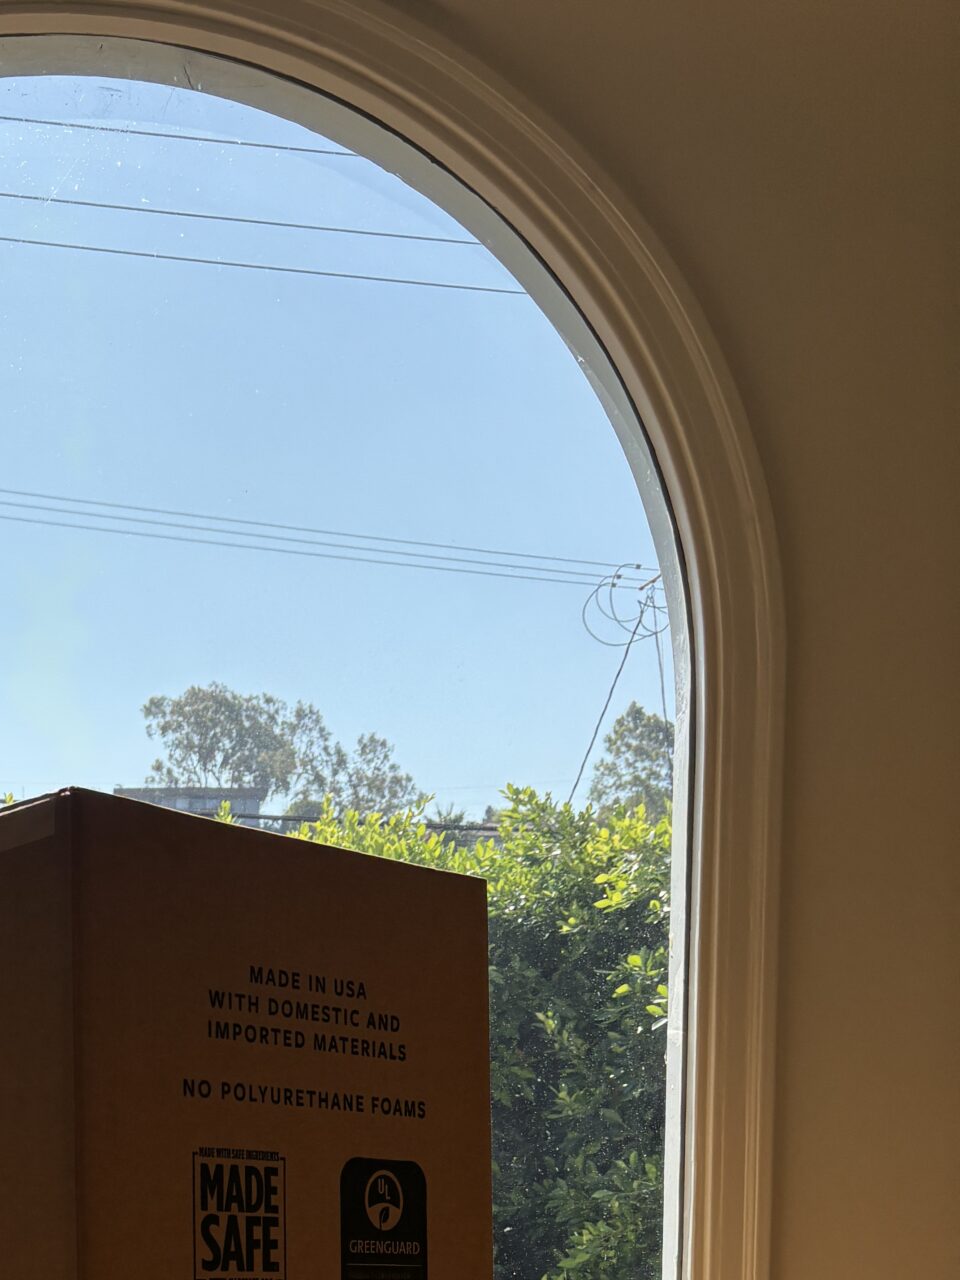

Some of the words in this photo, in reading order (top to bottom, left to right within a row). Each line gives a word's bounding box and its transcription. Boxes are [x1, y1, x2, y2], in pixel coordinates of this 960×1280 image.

[250, 965, 300, 990] MADE
[309, 974, 326, 994] IN
[334, 978, 367, 1000] USA
[209, 990, 259, 1013] WITH
[268, 998, 359, 1027] DOMESTIC
[367, 1012, 400, 1033] AND
[208, 1020, 305, 1048] IMPORTED
[313, 1033, 406, 1062] MATERIALS
[183, 1078, 211, 1098] NO
[221, 1082, 364, 1113] POLYURETHANE
[371, 1097, 426, 1119] FOAMS
[200, 1163, 279, 1214] MADE
[201, 1213, 280, 1273] SAFE
[349, 1240, 420, 1255] GREENGUARD
